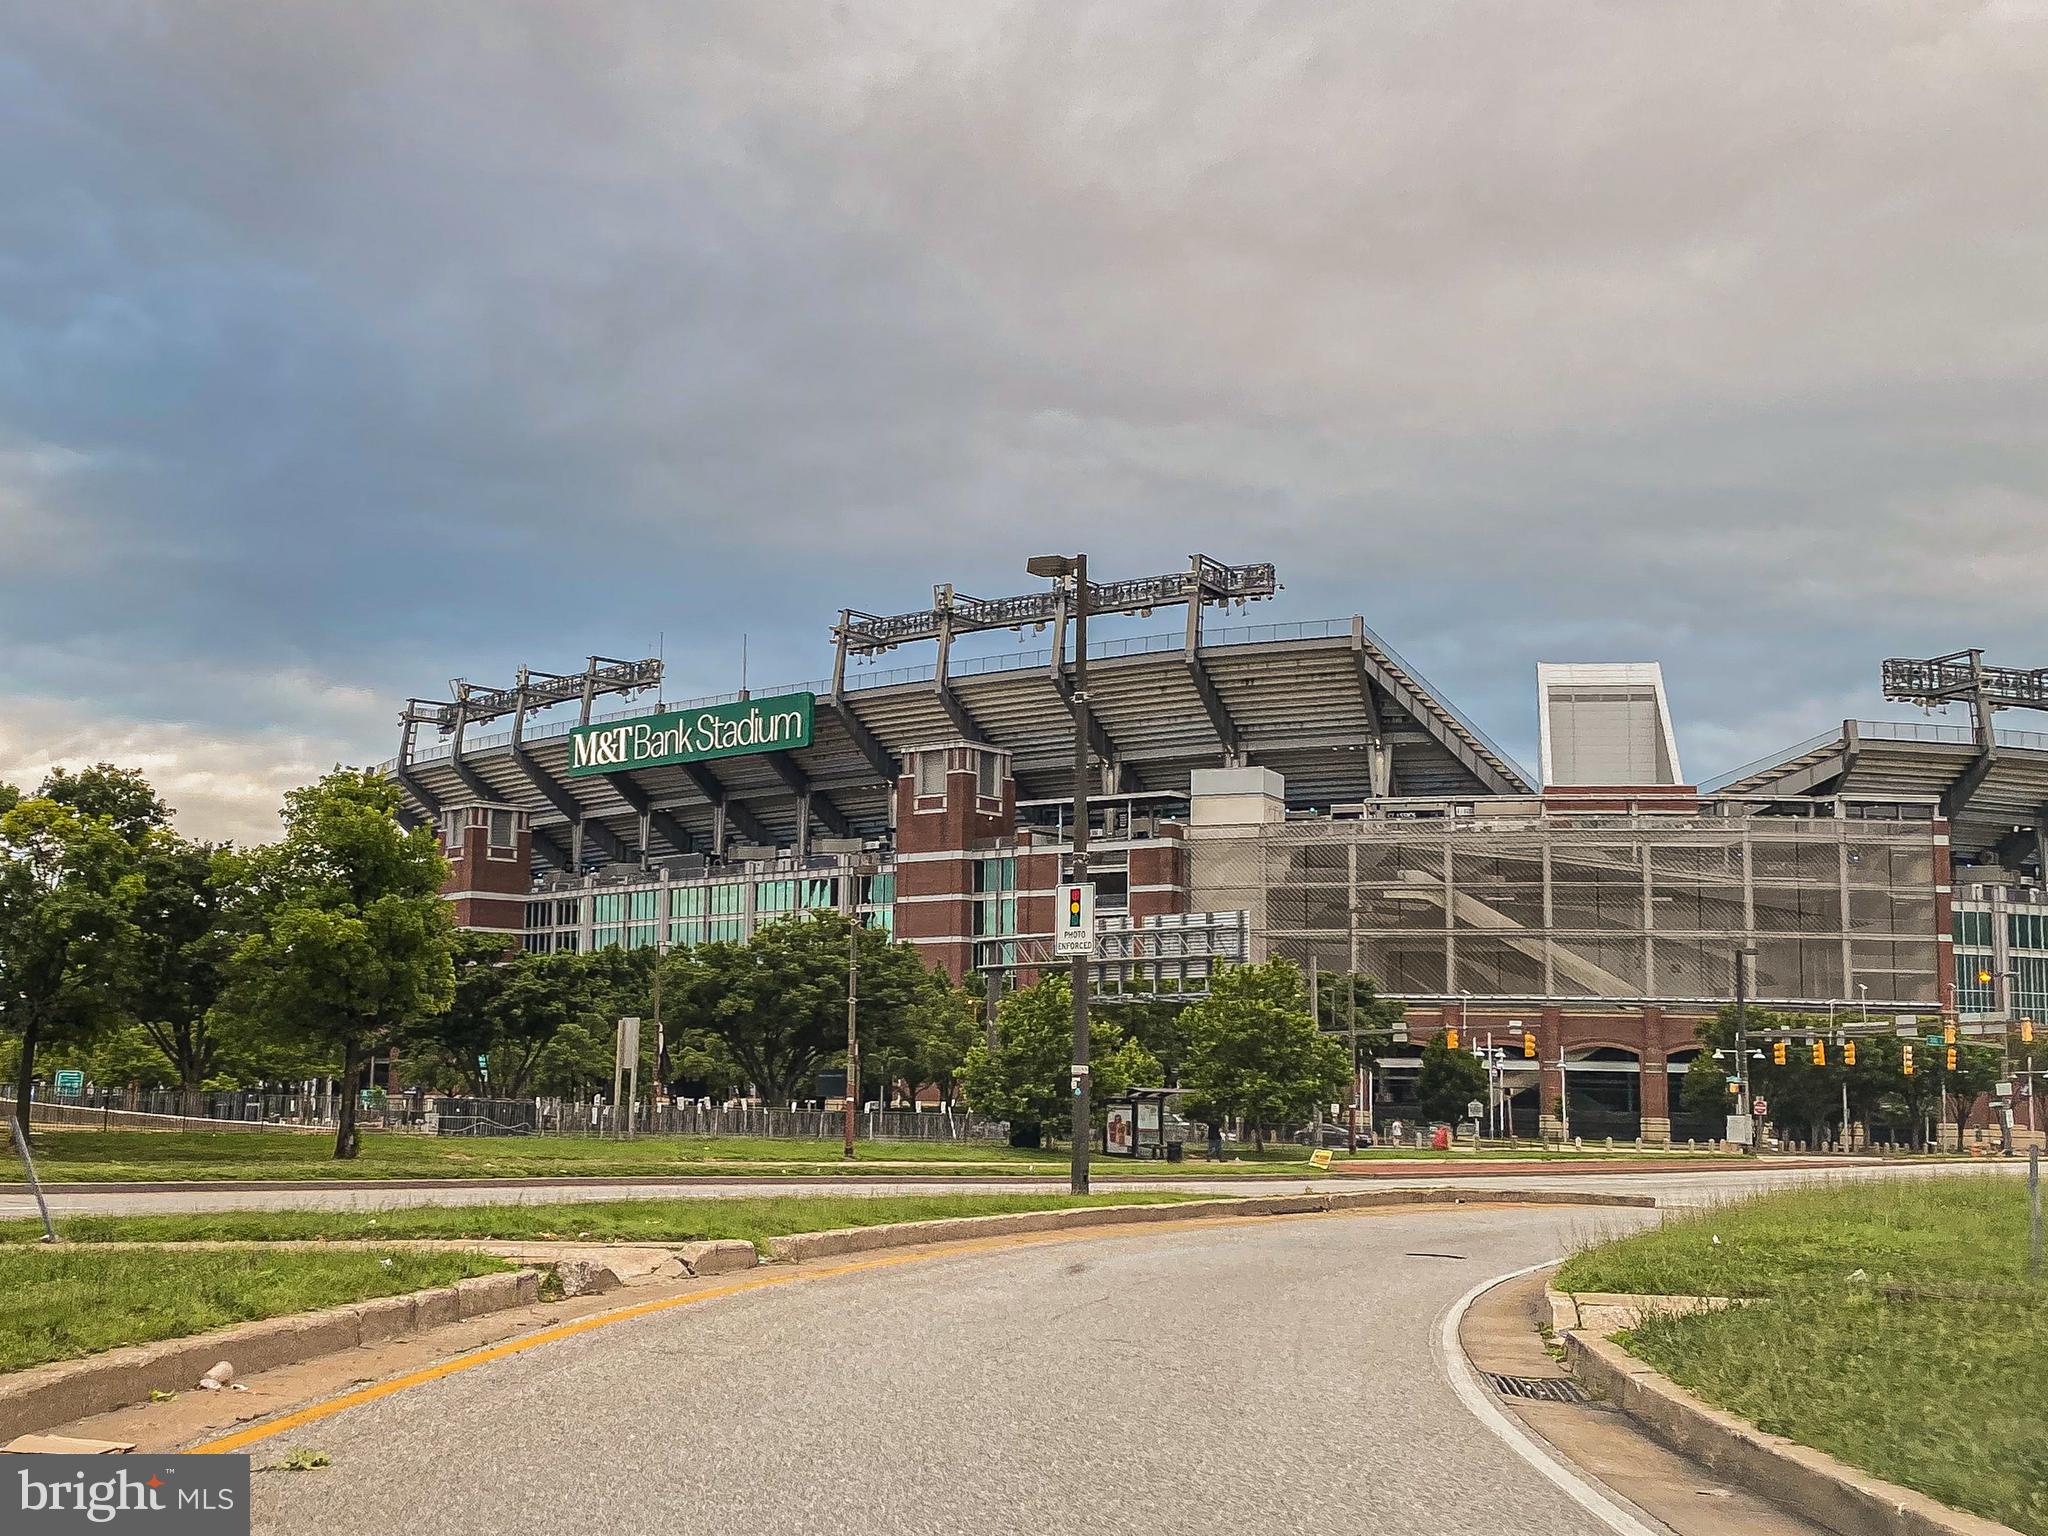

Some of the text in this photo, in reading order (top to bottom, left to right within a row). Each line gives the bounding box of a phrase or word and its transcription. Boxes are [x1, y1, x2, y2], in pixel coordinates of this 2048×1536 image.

[572, 708, 802, 768] M&T Bank Stadium
[1064, 931, 1086, 939] PHOTO
[1058, 942, 1092, 950] ENFORCED
